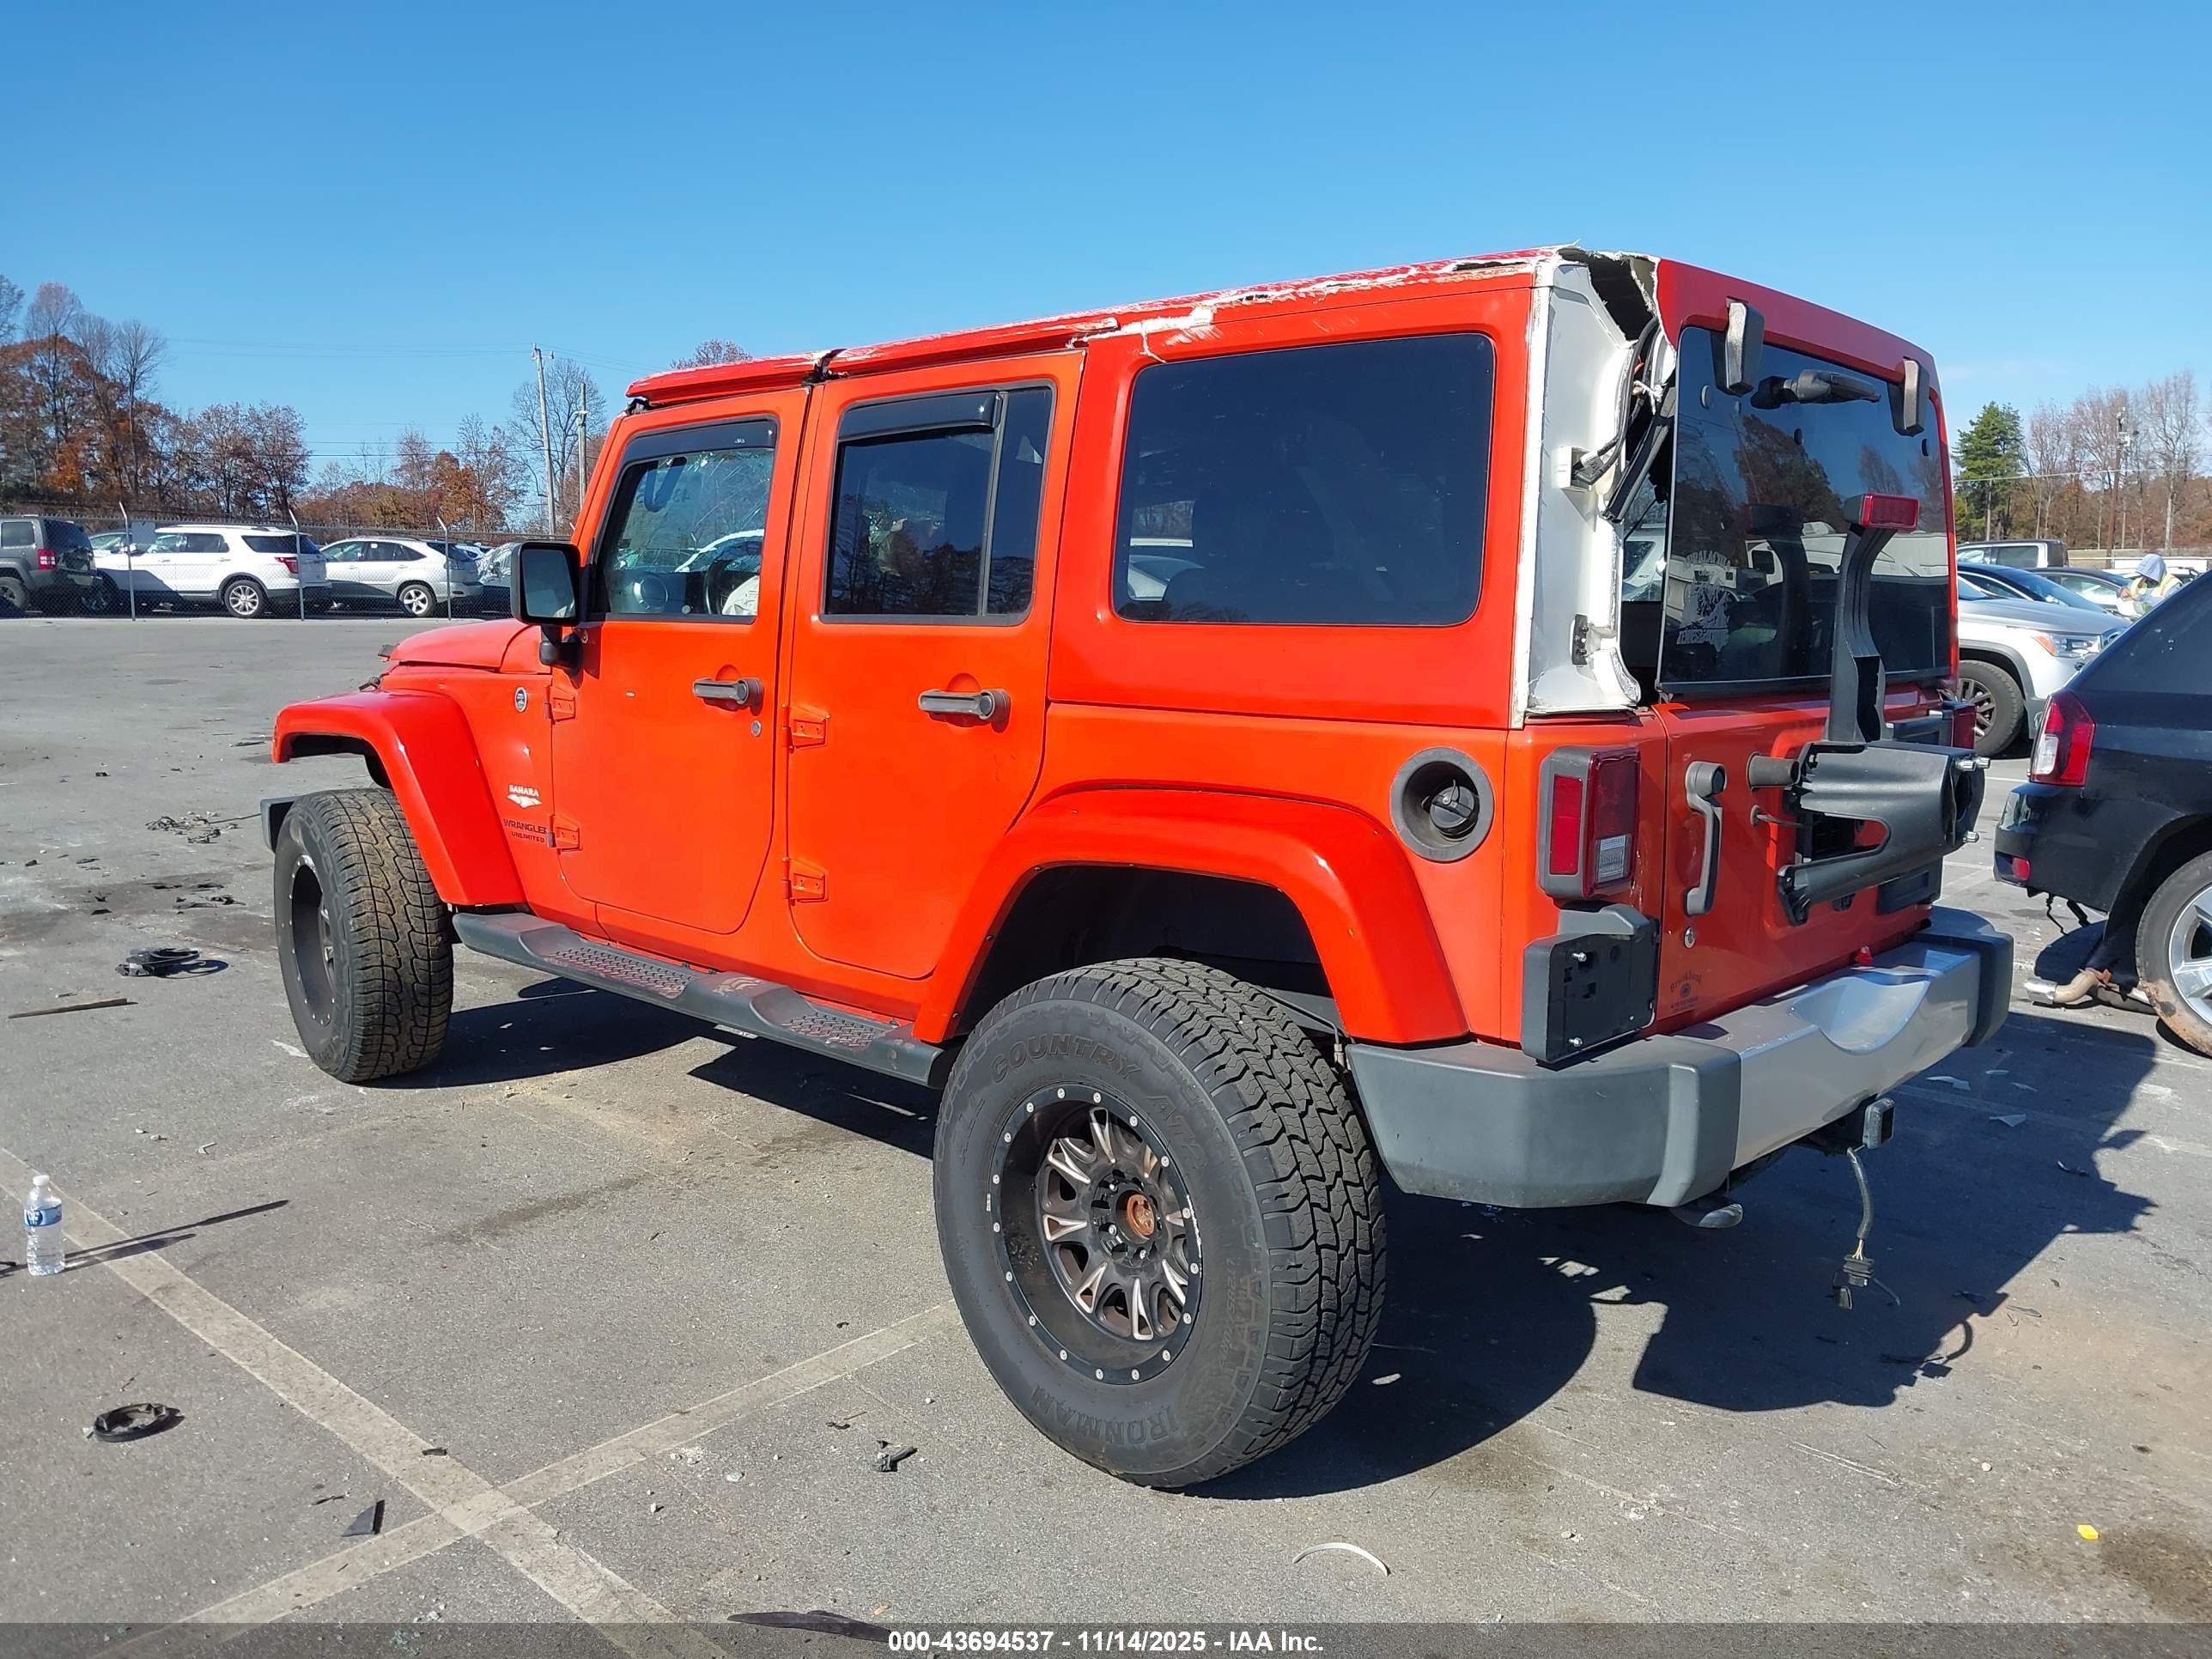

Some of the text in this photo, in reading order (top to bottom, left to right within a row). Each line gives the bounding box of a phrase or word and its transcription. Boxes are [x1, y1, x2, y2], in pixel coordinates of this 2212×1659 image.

[508, 784, 539, 797] SAHARA
[511, 830, 545, 843] UNLIMITED
[990, 1033, 1142, 1084] COUNTRY
[1032, 1385, 1176, 1445] IRONMAN
